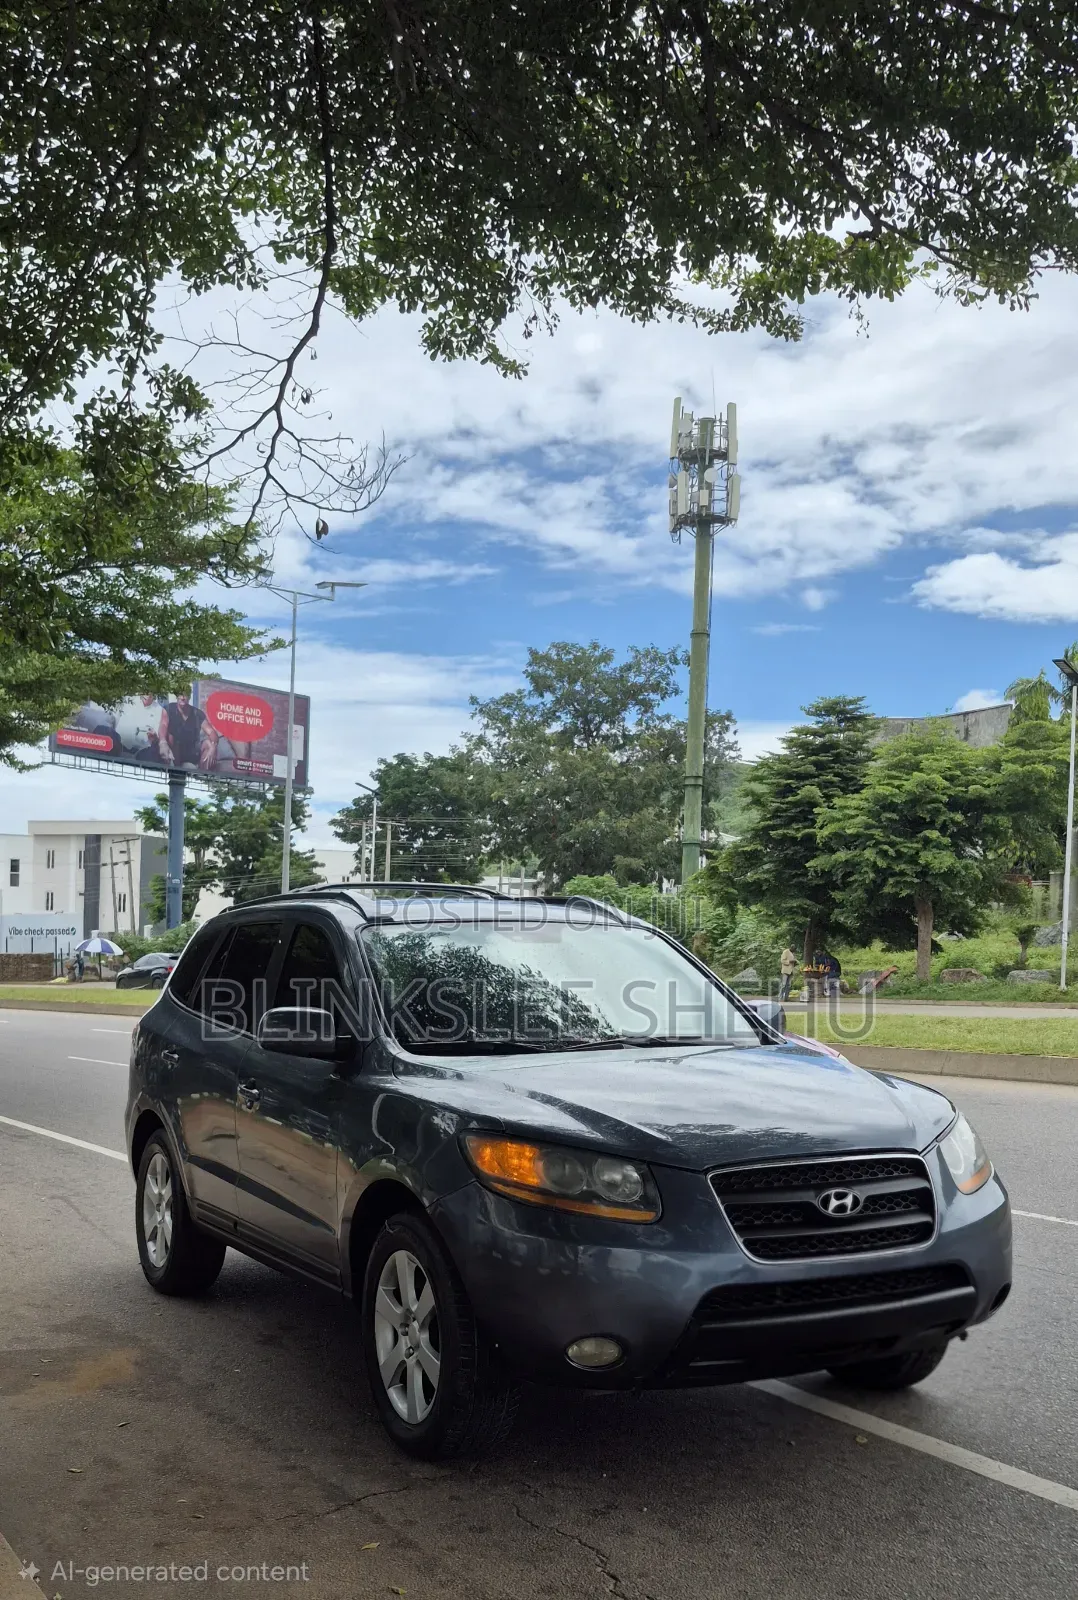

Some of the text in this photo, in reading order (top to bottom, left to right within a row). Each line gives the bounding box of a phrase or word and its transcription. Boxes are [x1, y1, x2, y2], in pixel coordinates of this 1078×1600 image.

[220, 702, 261, 717] HOME AND
[217, 711, 245, 724] OFFICE
[8, 927, 71, 938] Vibe check passed
